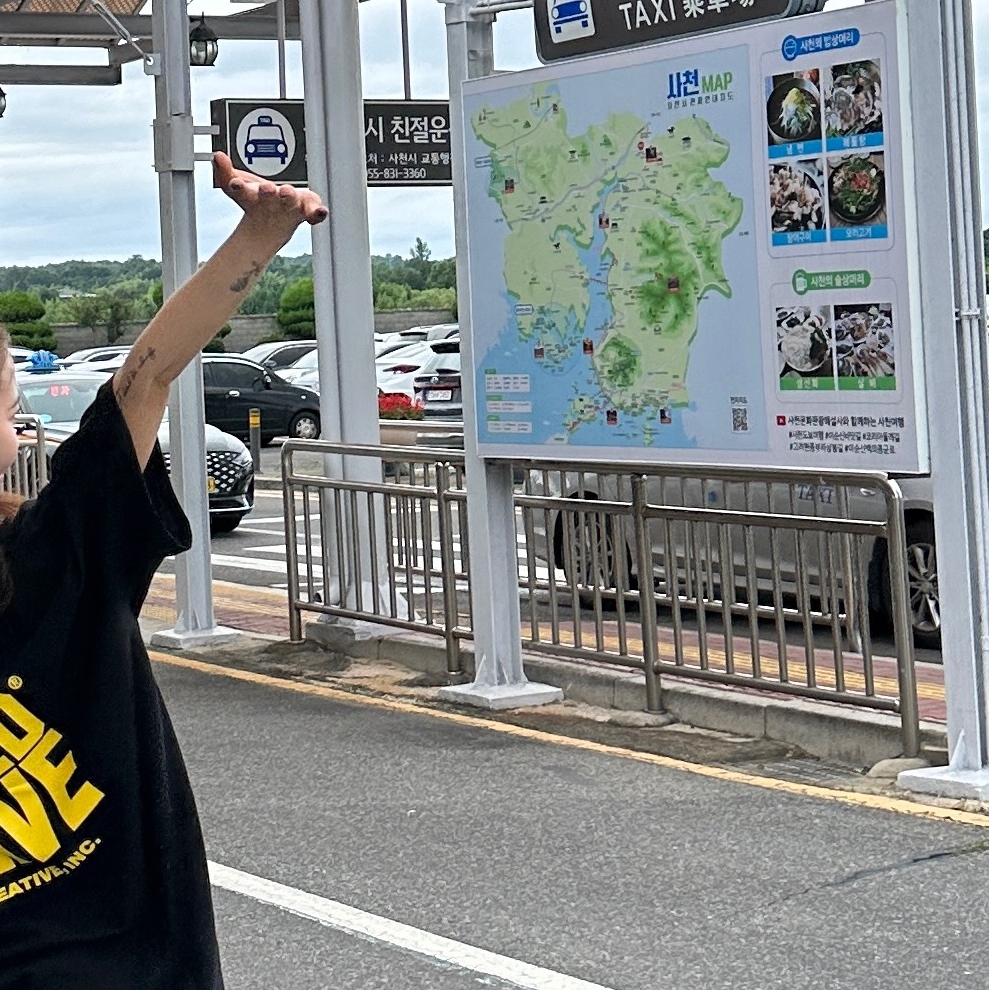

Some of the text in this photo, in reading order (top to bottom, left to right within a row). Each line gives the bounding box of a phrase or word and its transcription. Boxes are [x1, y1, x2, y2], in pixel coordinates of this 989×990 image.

[618, 0, 676, 30] TAXI
[667, 68, 733, 99] 사천 MAP
[390, 115, 450, 144] 친절운
[388, 151, 418, 166] 사천시
[420, 151, 451, 165] 교통행
[810, 273, 833, 288] 사천의
